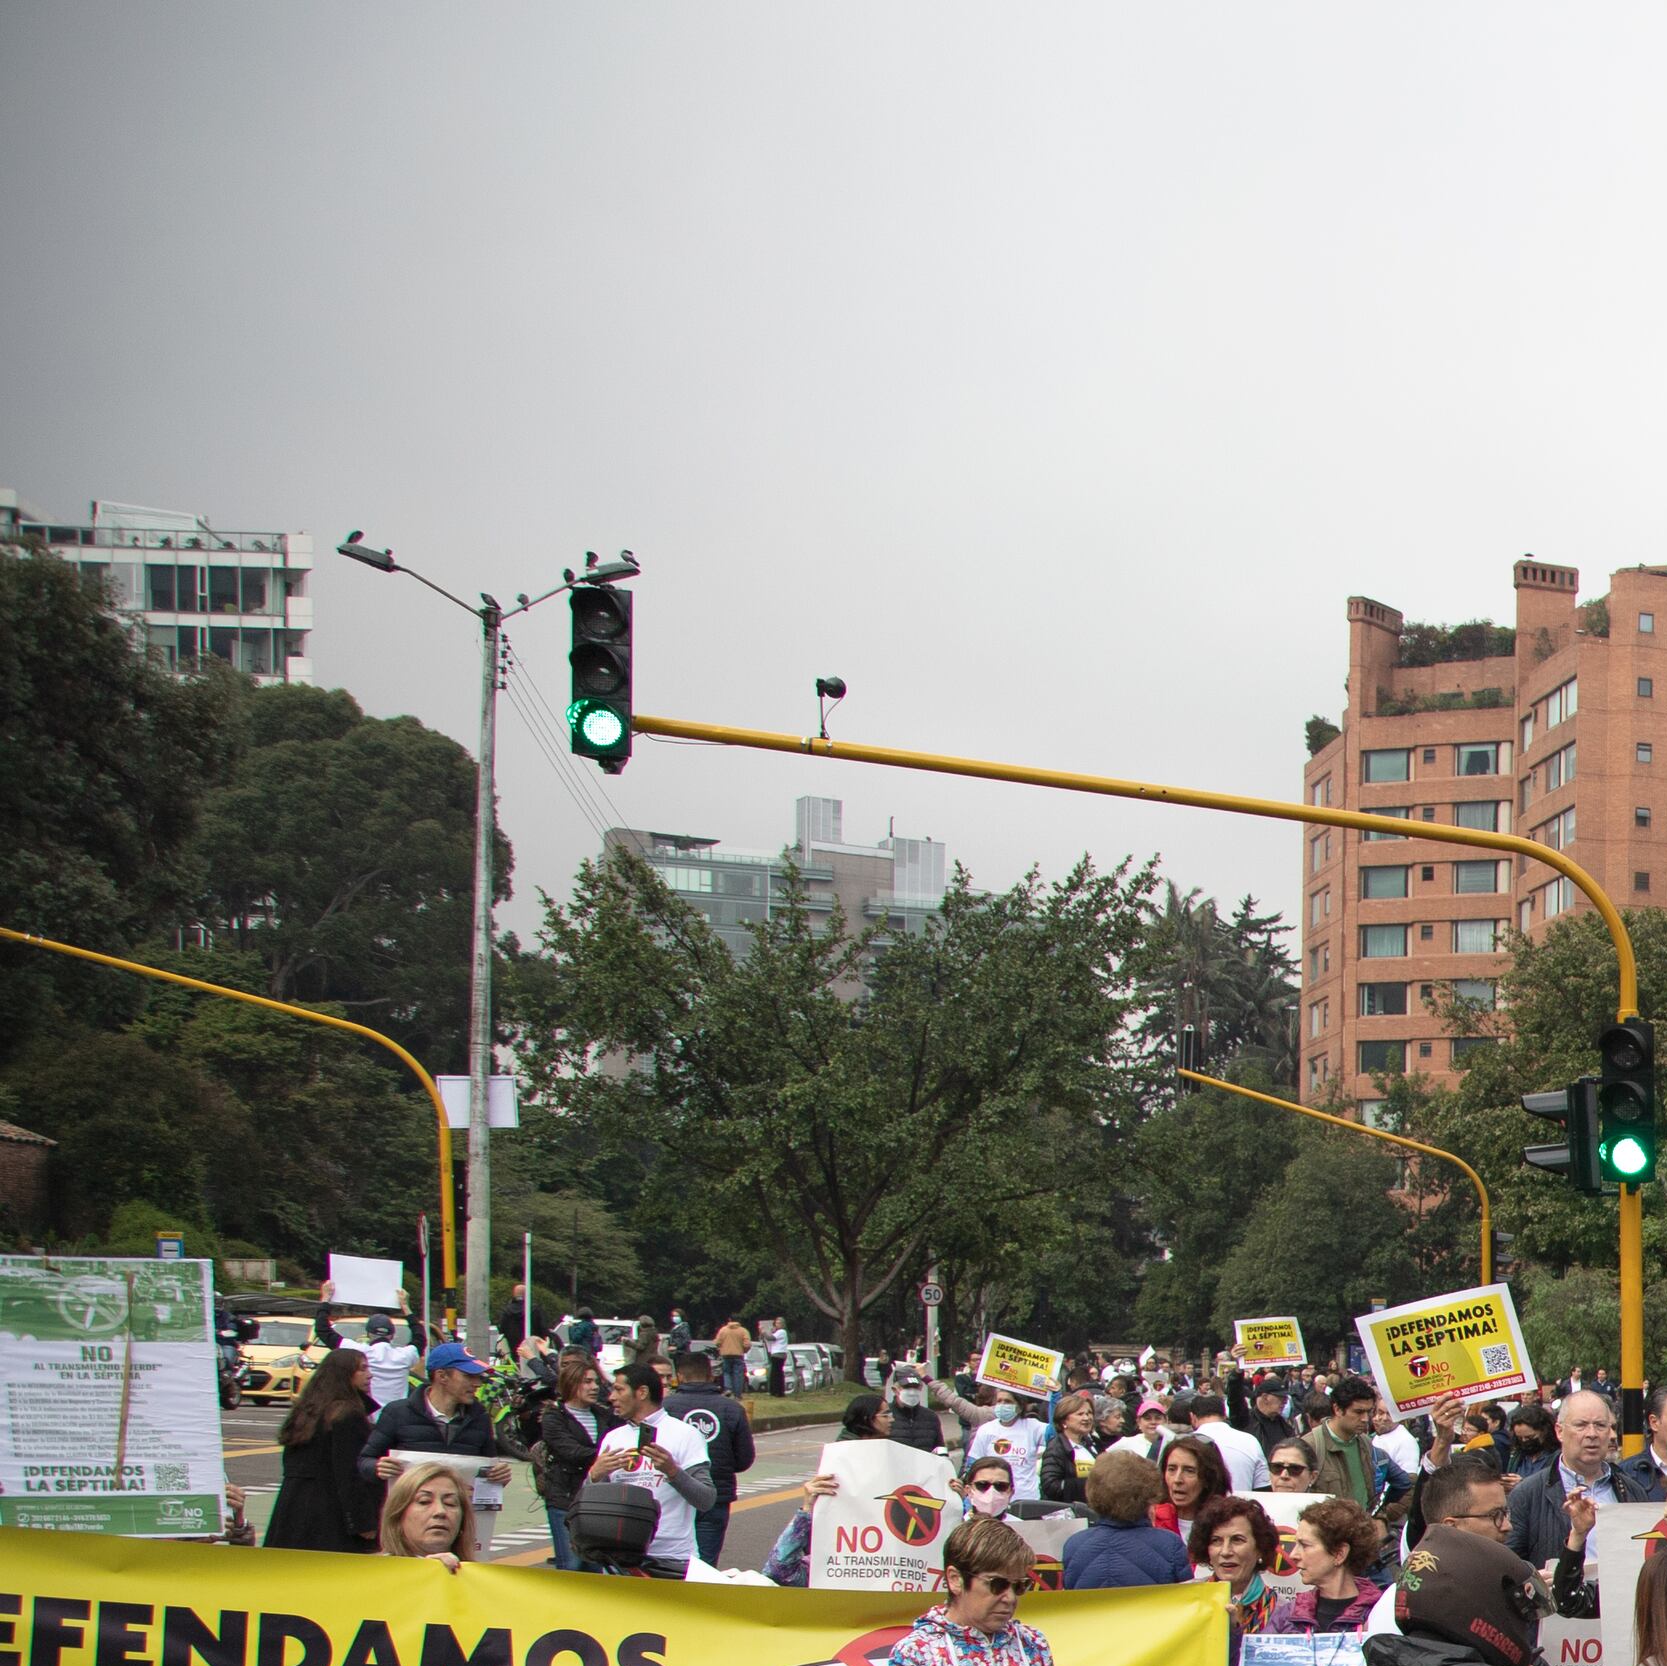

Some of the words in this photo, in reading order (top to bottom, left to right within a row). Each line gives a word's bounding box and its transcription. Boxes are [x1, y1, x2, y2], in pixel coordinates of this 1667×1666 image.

[924, 1288, 941, 1301] 50
[1385, 1303, 1494, 1341] ¡DEFENDAMOS
[1247, 1333, 1257, 1341] LA
[1390, 1343, 1412, 1358] LA
[1415, 1317, 1498, 1351] SÉPTIMA!
[81, 1346, 113, 1363] NO
[995, 1351, 1006, 1361] LA
[996, 1343, 1050, 1363] ¡DEFENDAMOS
[1431, 1361, 1449, 1375] NO
[77, 1372, 90, 1381] LA
[1012, 1447, 1027, 1455] NO
[25, 1480, 50, 1492] LA
[184, 1507, 204, 1518] NO
[836, 1525, 884, 1554] NO
[827, 1555, 841, 1566] AL
[843, 1555, 928, 1569] TRANSMILENIO/
[826, 1567, 890, 1579] CORREDOR
[893, 1569, 928, 1582] VERDE
[1560, 1638, 1603, 1664] NO
